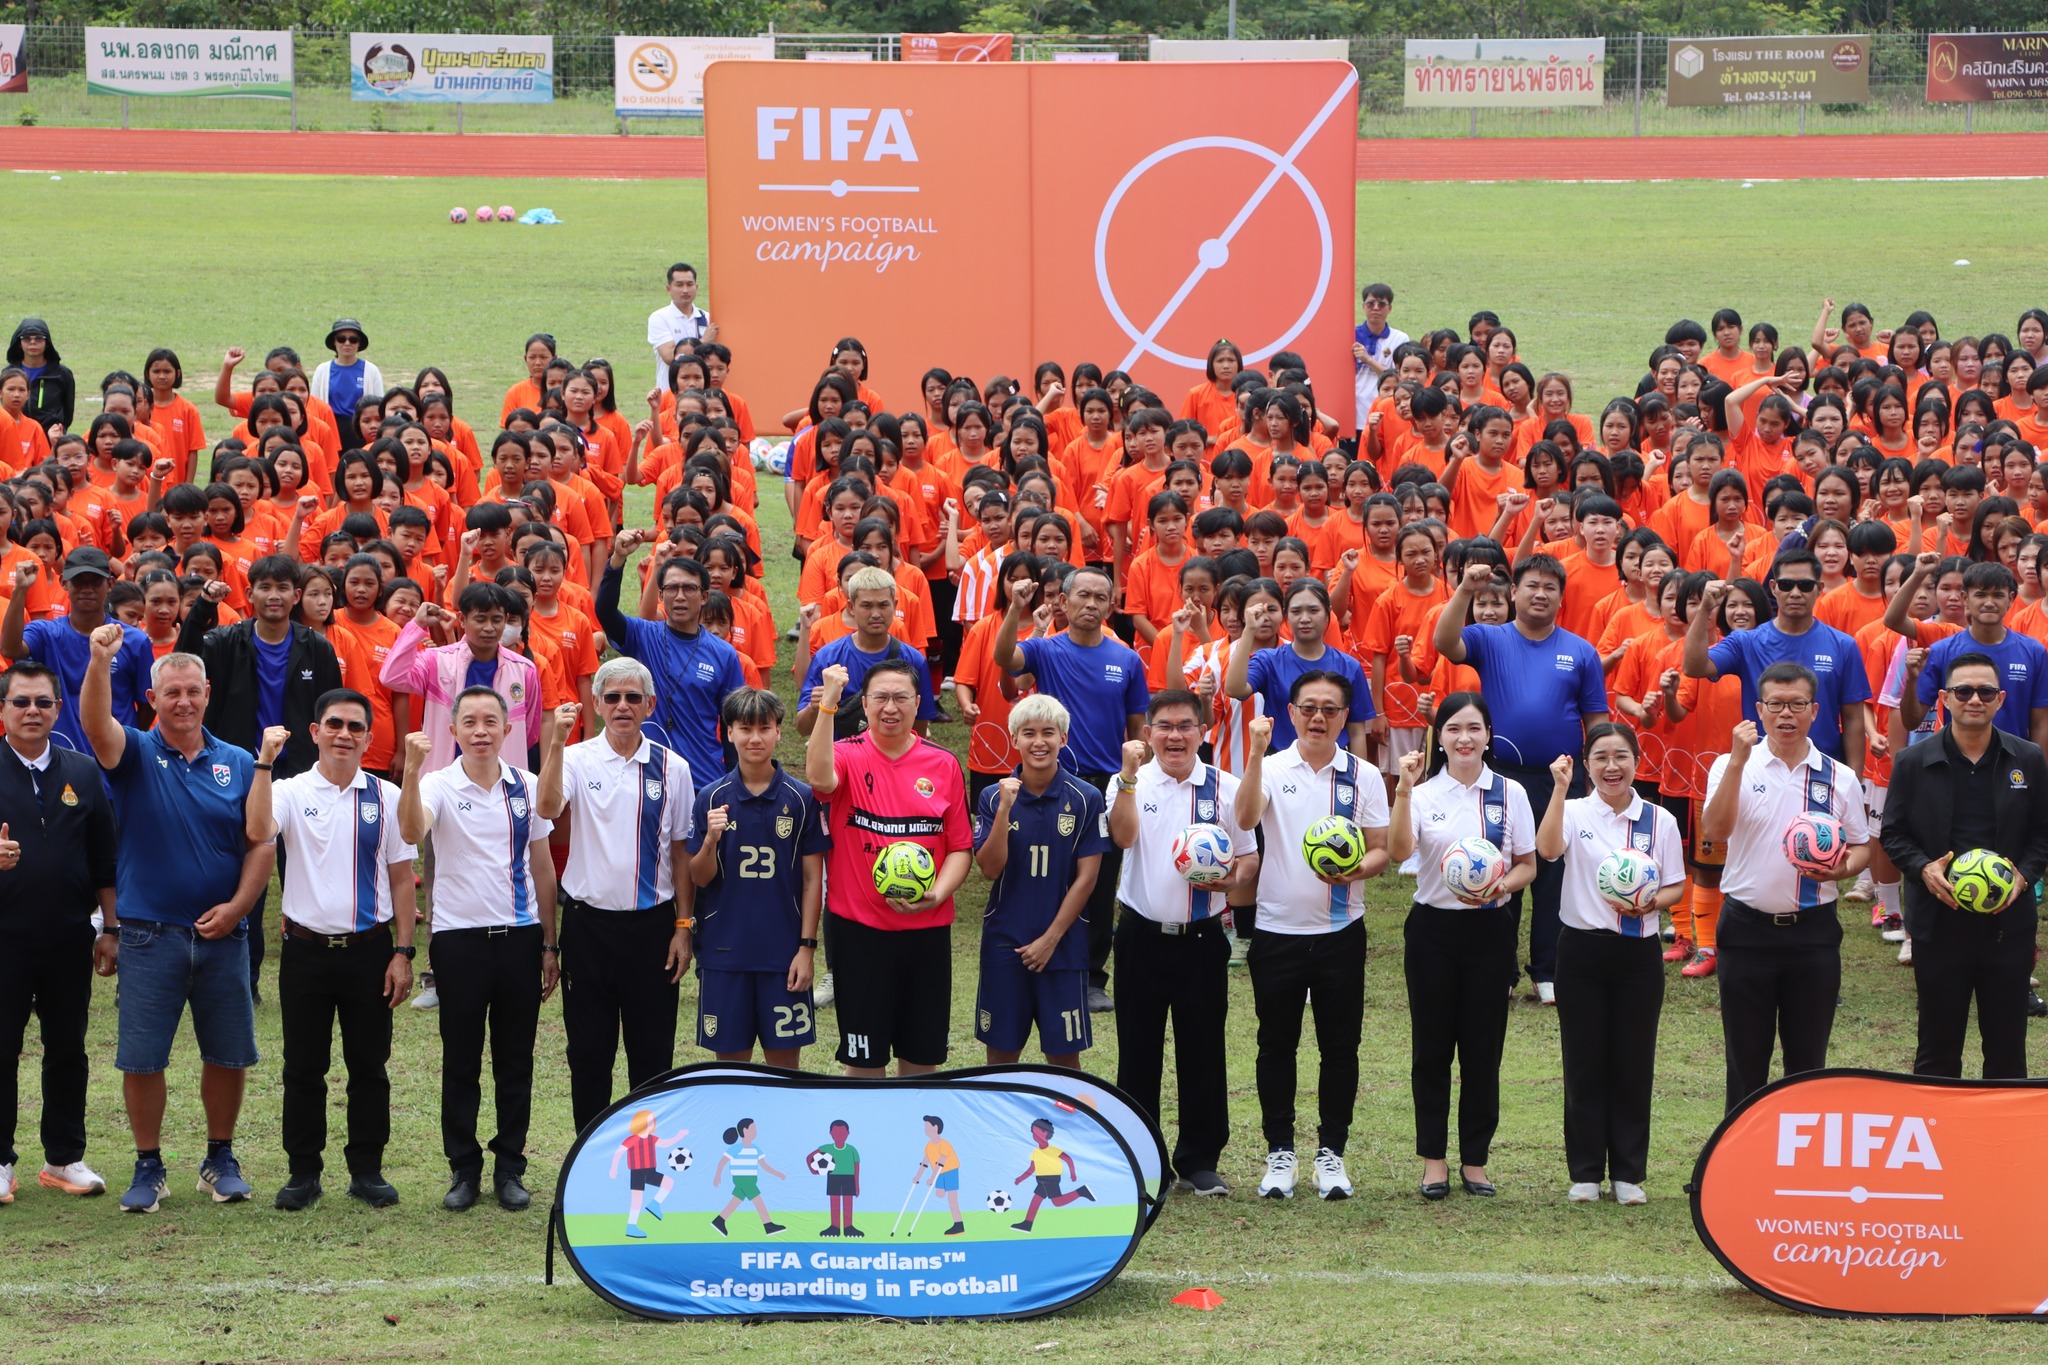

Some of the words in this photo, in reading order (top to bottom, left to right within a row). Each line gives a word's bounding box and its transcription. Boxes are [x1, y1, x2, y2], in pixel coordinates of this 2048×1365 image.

[100, 40, 200, 60] นพ.อลงกต
[208, 36, 278, 62] มณีกาศ
[911, 37, 938, 48] FIFA
[1712, 48, 1752, 62] โรงแรม
[1756, 50, 1783, 61] THE
[1786, 49, 1825, 60] ROOM
[170, 70, 188, 81] เขต
[193, 71, 200, 81] 3
[205, 67, 279, 87] พรรคภูมิใจไทย
[1414, 54, 1596, 93] ท่าทรายนพรัตน์
[1720, 66, 1817, 89] ห้างทองบูรพา
[1986, 78, 2026, 88] MARINA
[623, 96, 637, 104] NO
[640, 96, 685, 104] SMOKING
[1722, 92, 1743, 103] Tel.
[1745, 90, 1812, 102] 042-512-144
[742, 215, 836, 232] WOMEN'S
[841, 216, 938, 233] FOOTBALL
[756, 233, 921, 273] campaign
[238, 557, 252, 567] FIFA
[51, 603, 65, 611] FIFA
[562, 631, 576, 639] FIFA
[1556, 654, 1574, 662] FIFA
[1815, 654, 1833, 663] FIFA
[2009, 663, 2027, 671] FIFA
[698, 662, 715, 673] FIFA
[1105, 664, 1123, 673] FIFA
[864, 772, 874, 795] 9
[854, 814, 906, 833] นพ.อลงกต
[739, 845, 776, 879] 23
[1029, 845, 1049, 878] 11
[773, 1002, 812, 1038] 23
[1061, 1008, 1082, 1042] 11
[847, 1033, 869, 1059] 84
[1755, 1218, 1856, 1237] WOMEN'S
[1861, 1222, 1964, 1240] FOOTBALL
[741, 1252, 802, 1270] FIFA
[1773, 1239, 1946, 1280] campaign
[690, 1278, 867, 1301] Safeguarding
[876, 1278, 900, 1297] in
[910, 1274, 1018, 1296] Football
